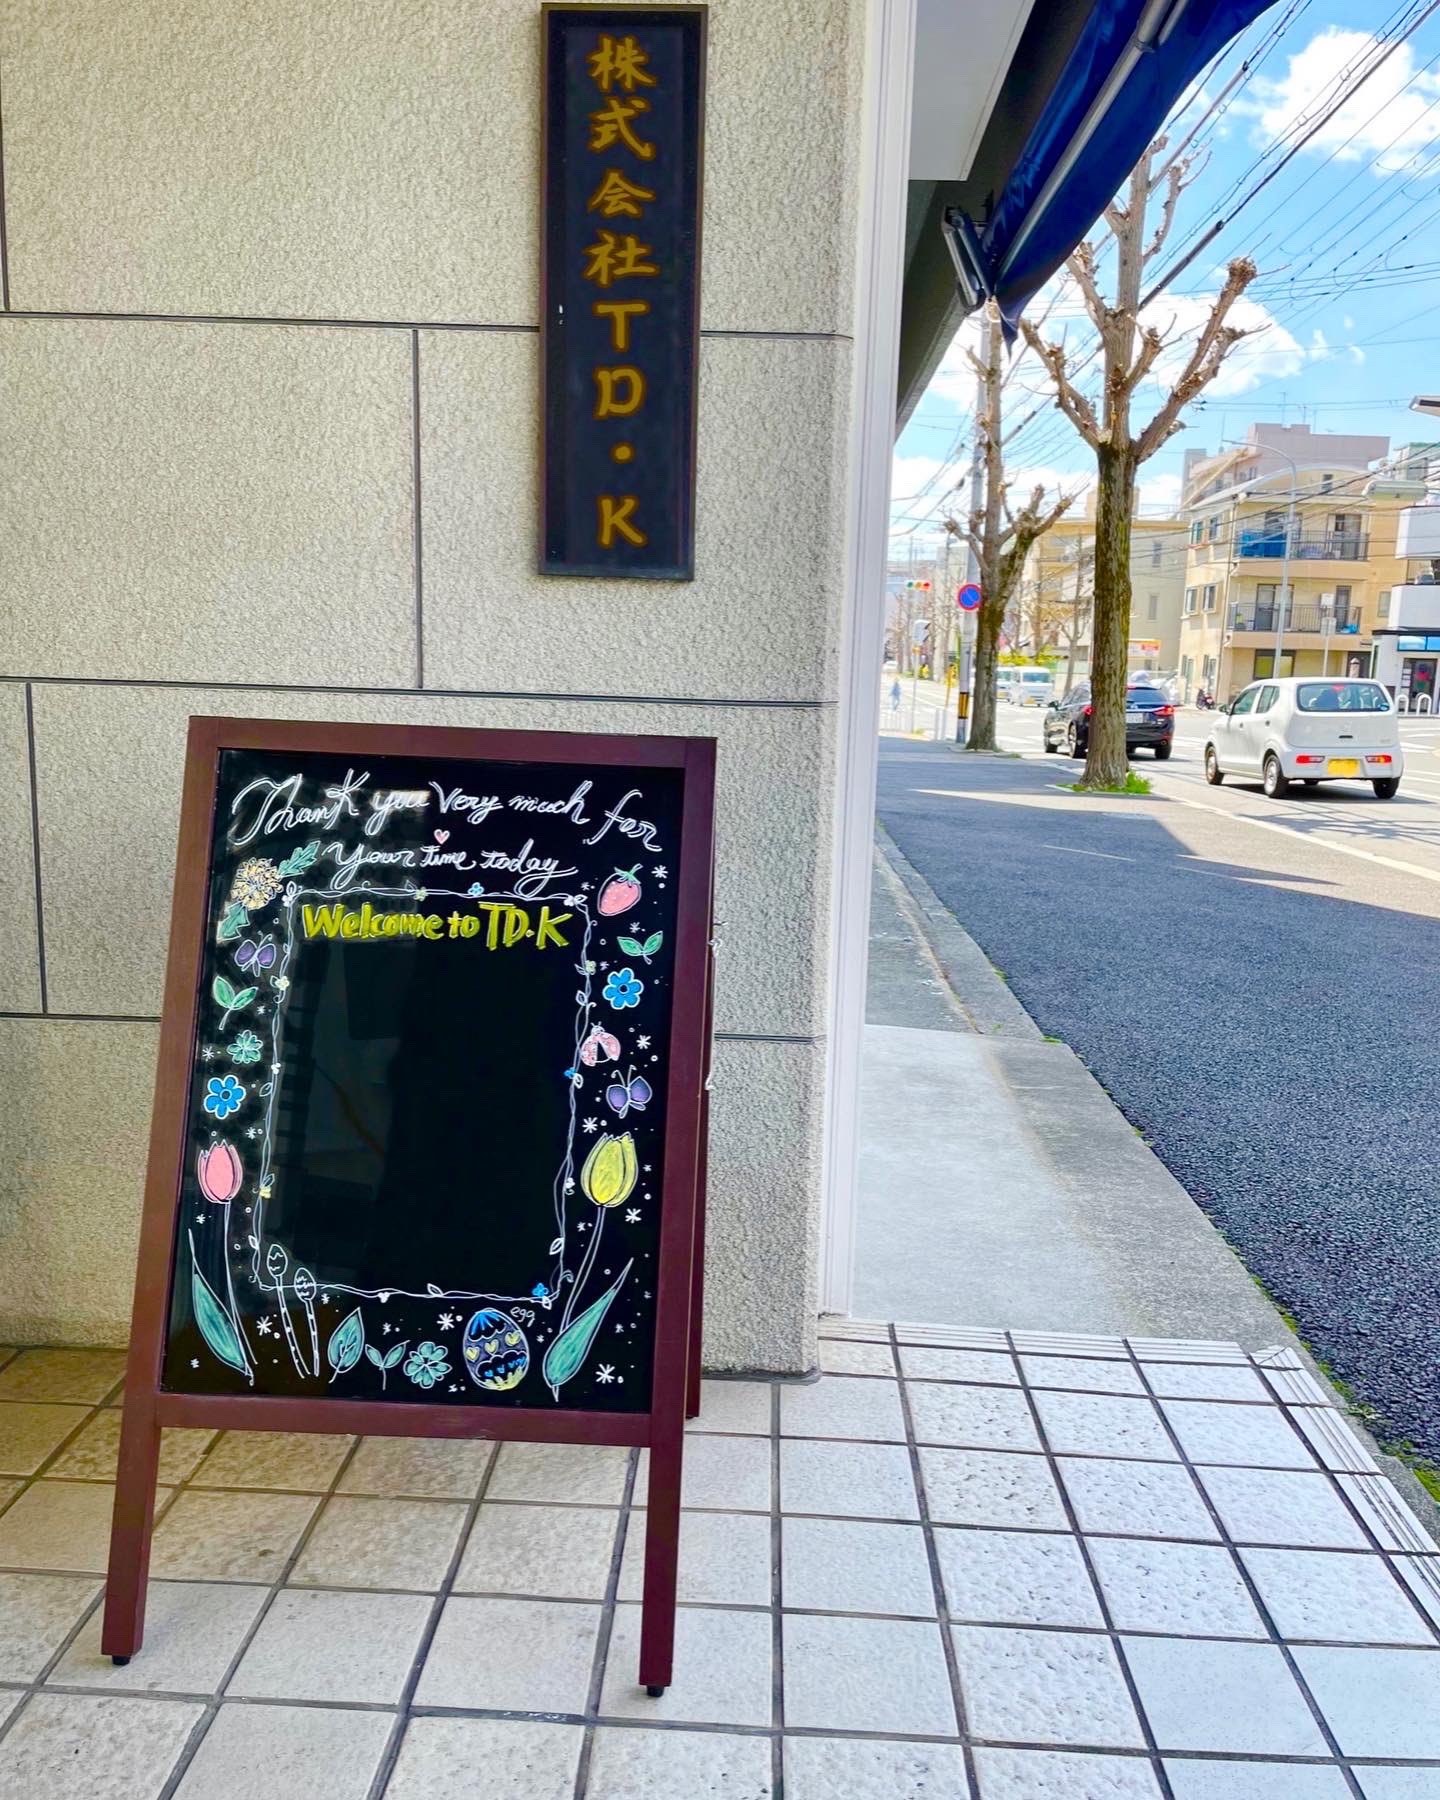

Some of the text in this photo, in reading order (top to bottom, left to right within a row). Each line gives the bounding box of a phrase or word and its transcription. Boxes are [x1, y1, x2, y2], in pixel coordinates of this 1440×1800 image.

[584, 34, 658, 545] 株式会社TD・K
[365, 790, 430, 836] you
[508, 780, 592, 825] much
[480, 838, 579, 900] today
[302, 902, 445, 940] Welcome
[447, 911, 480, 939] to
[510, 1306, 536, 1328] egg
